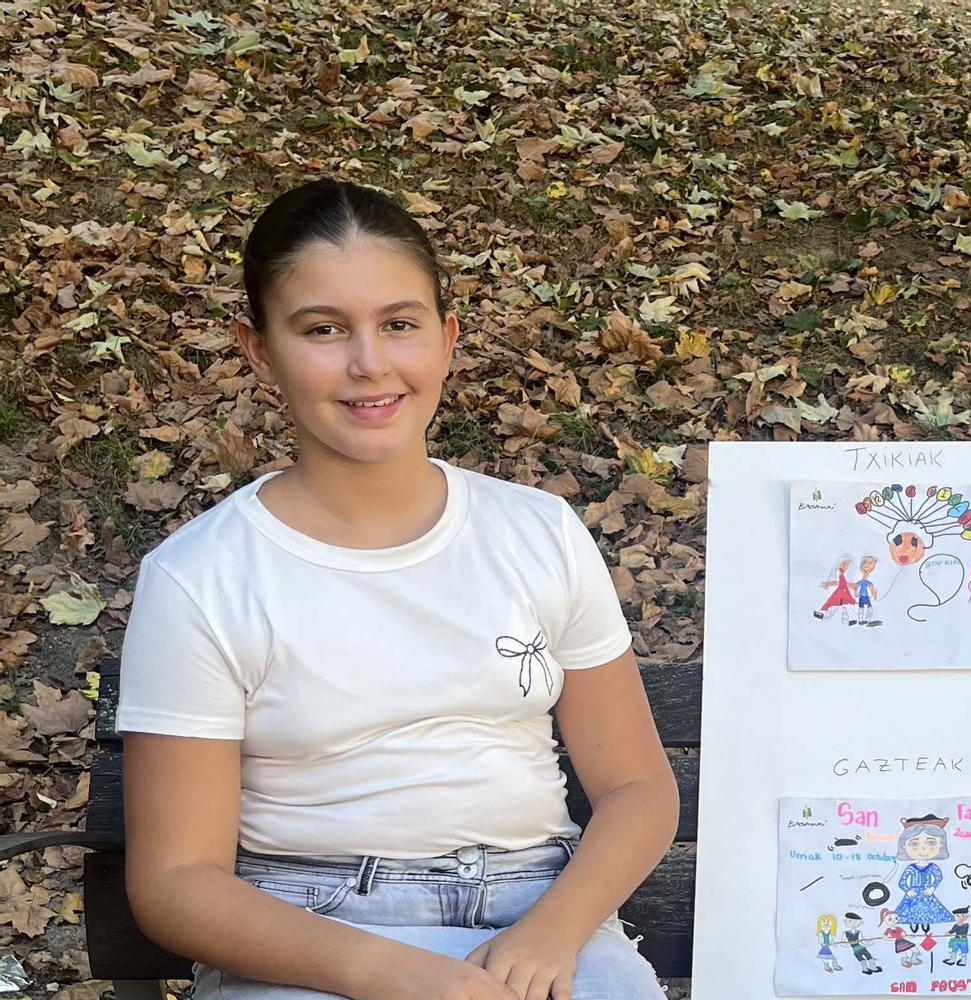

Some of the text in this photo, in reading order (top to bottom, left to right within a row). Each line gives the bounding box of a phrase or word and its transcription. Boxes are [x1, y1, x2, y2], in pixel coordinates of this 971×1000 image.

[845, 448, 943, 471] TXIKIAK
[833, 757, 966, 776] GAZTEAK
[837, 802, 879, 828] San
